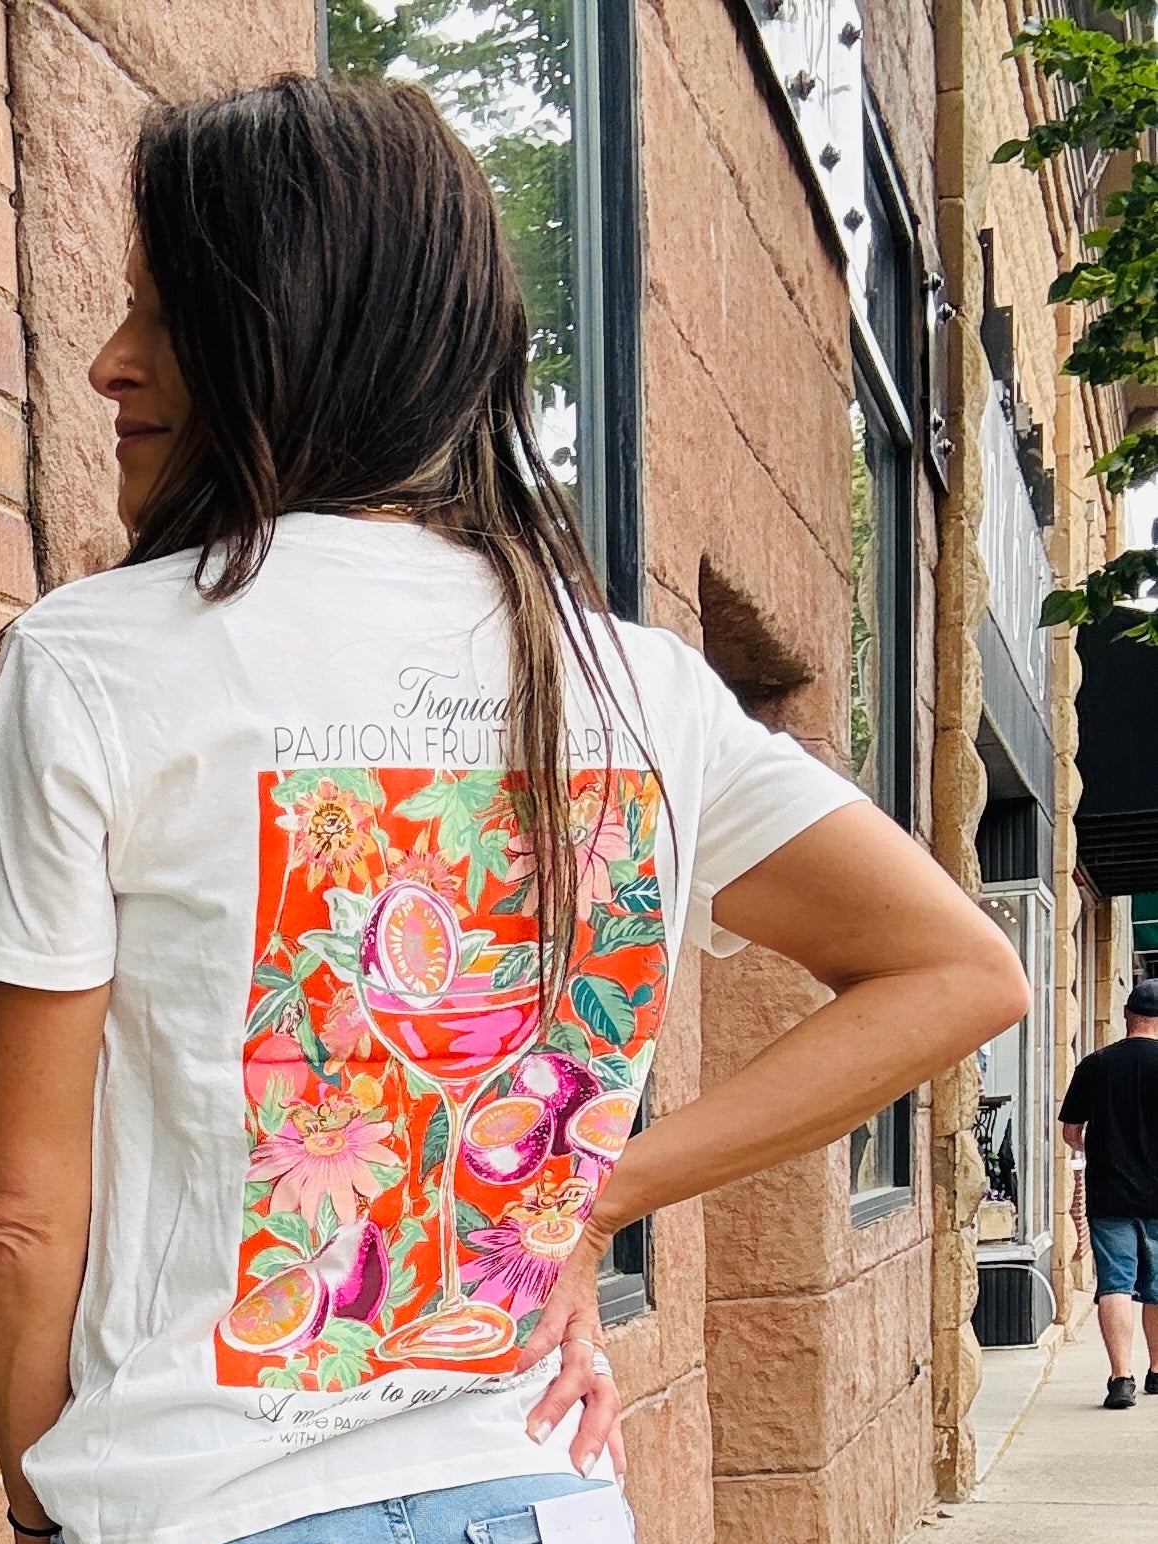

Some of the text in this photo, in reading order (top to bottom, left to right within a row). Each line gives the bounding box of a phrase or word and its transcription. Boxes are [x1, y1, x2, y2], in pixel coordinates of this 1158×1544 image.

[394, 667, 513, 736] Tropica
[273, 723, 412, 764] PASSION
[425, 726, 507, 765] FRUIT
[380, 1381, 405, 1403] to
[403, 1384, 448, 1410] get
